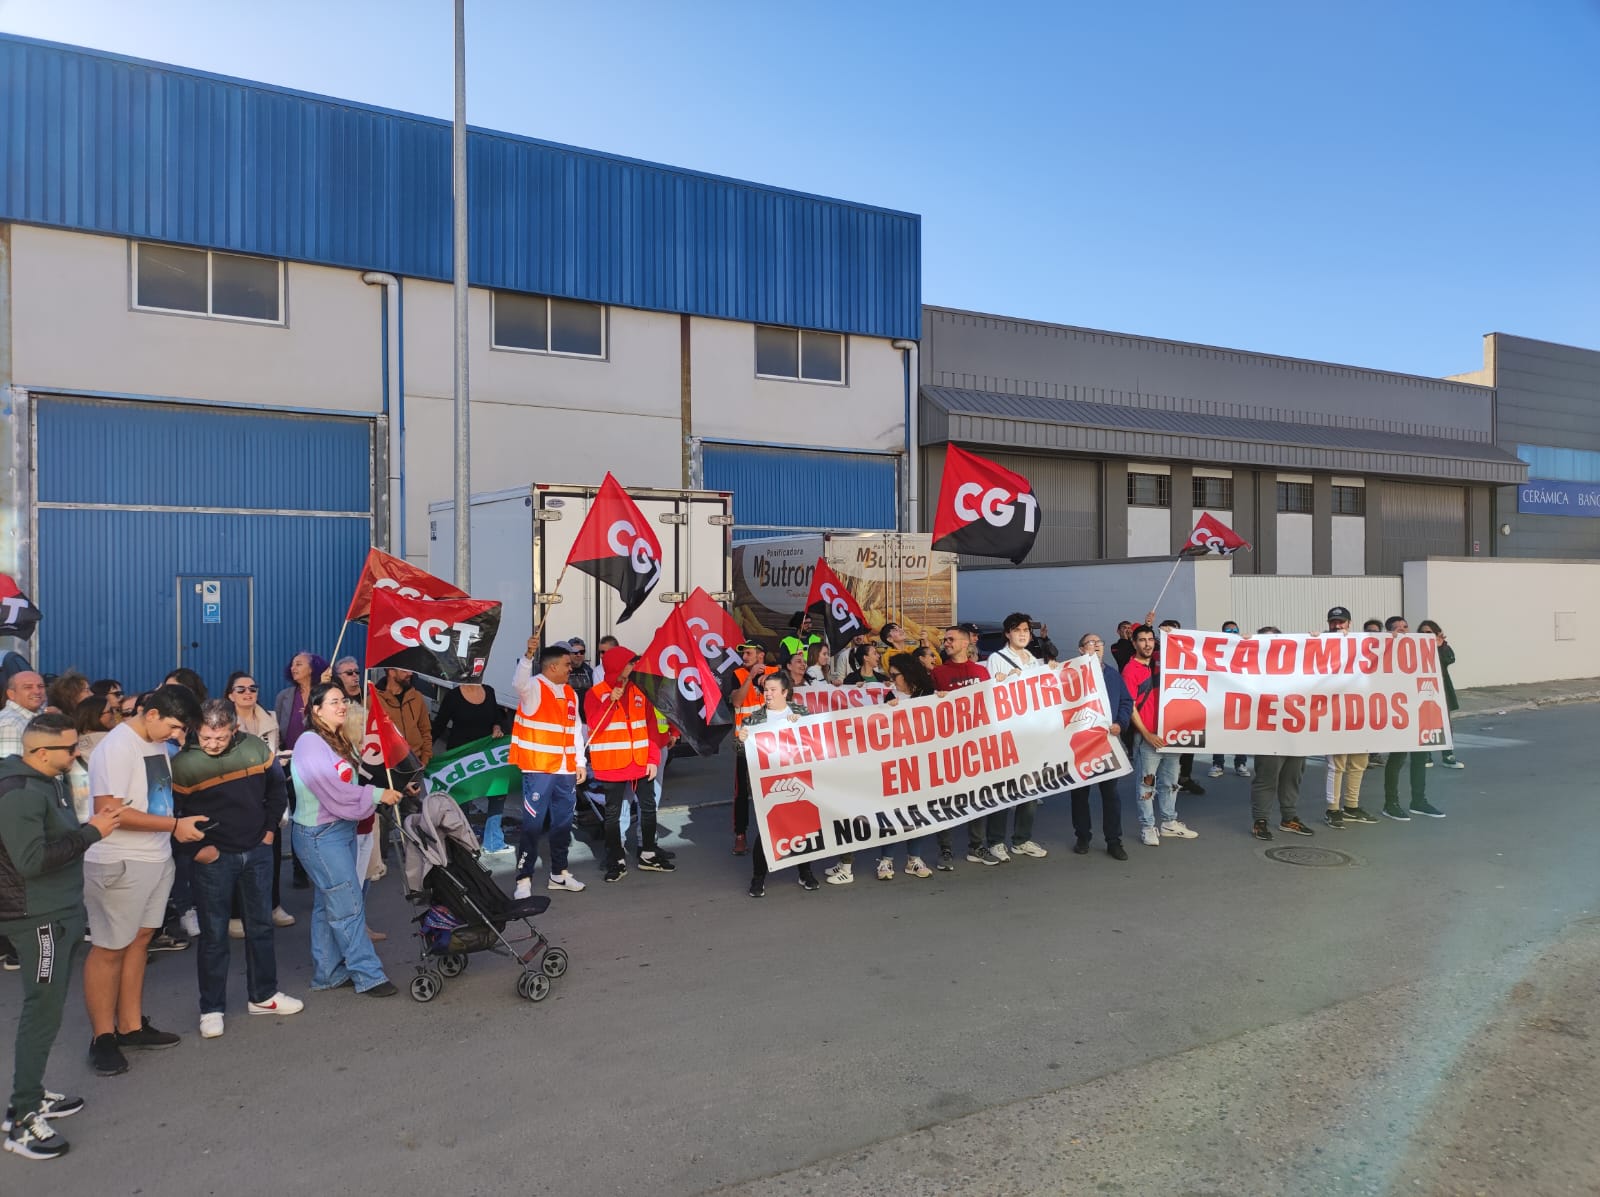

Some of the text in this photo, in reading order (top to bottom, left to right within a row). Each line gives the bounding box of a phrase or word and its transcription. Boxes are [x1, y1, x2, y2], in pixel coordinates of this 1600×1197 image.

[955, 482, 1037, 532] CGT
[1522, 488, 1569, 504] CERÁMICA
[607, 520, 661, 593] CGT
[820, 582, 860, 633] CGT
[390, 617, 480, 658] CGT
[1165, 635, 1437, 675] READMISION
[658, 645, 706, 720] CG
[755, 661, 1098, 770] PANIFICADORA BUTRÓN
[1223, 692, 1410, 733] DESPIDOS
[1166, 729, 1203, 746] CGT
[1421, 728, 1442, 744] CGT
[881, 730, 1020, 797] EN LUCHA
[1079, 752, 1115, 777] CGT
[775, 831, 820, 857] CGT
[833, 815, 872, 846] NO
[875, 811, 897, 843] A
[895, 804, 931, 833] LA
[41, 934, 52, 957] DEGREES
[41, 957, 51, 978] ELEVEN
